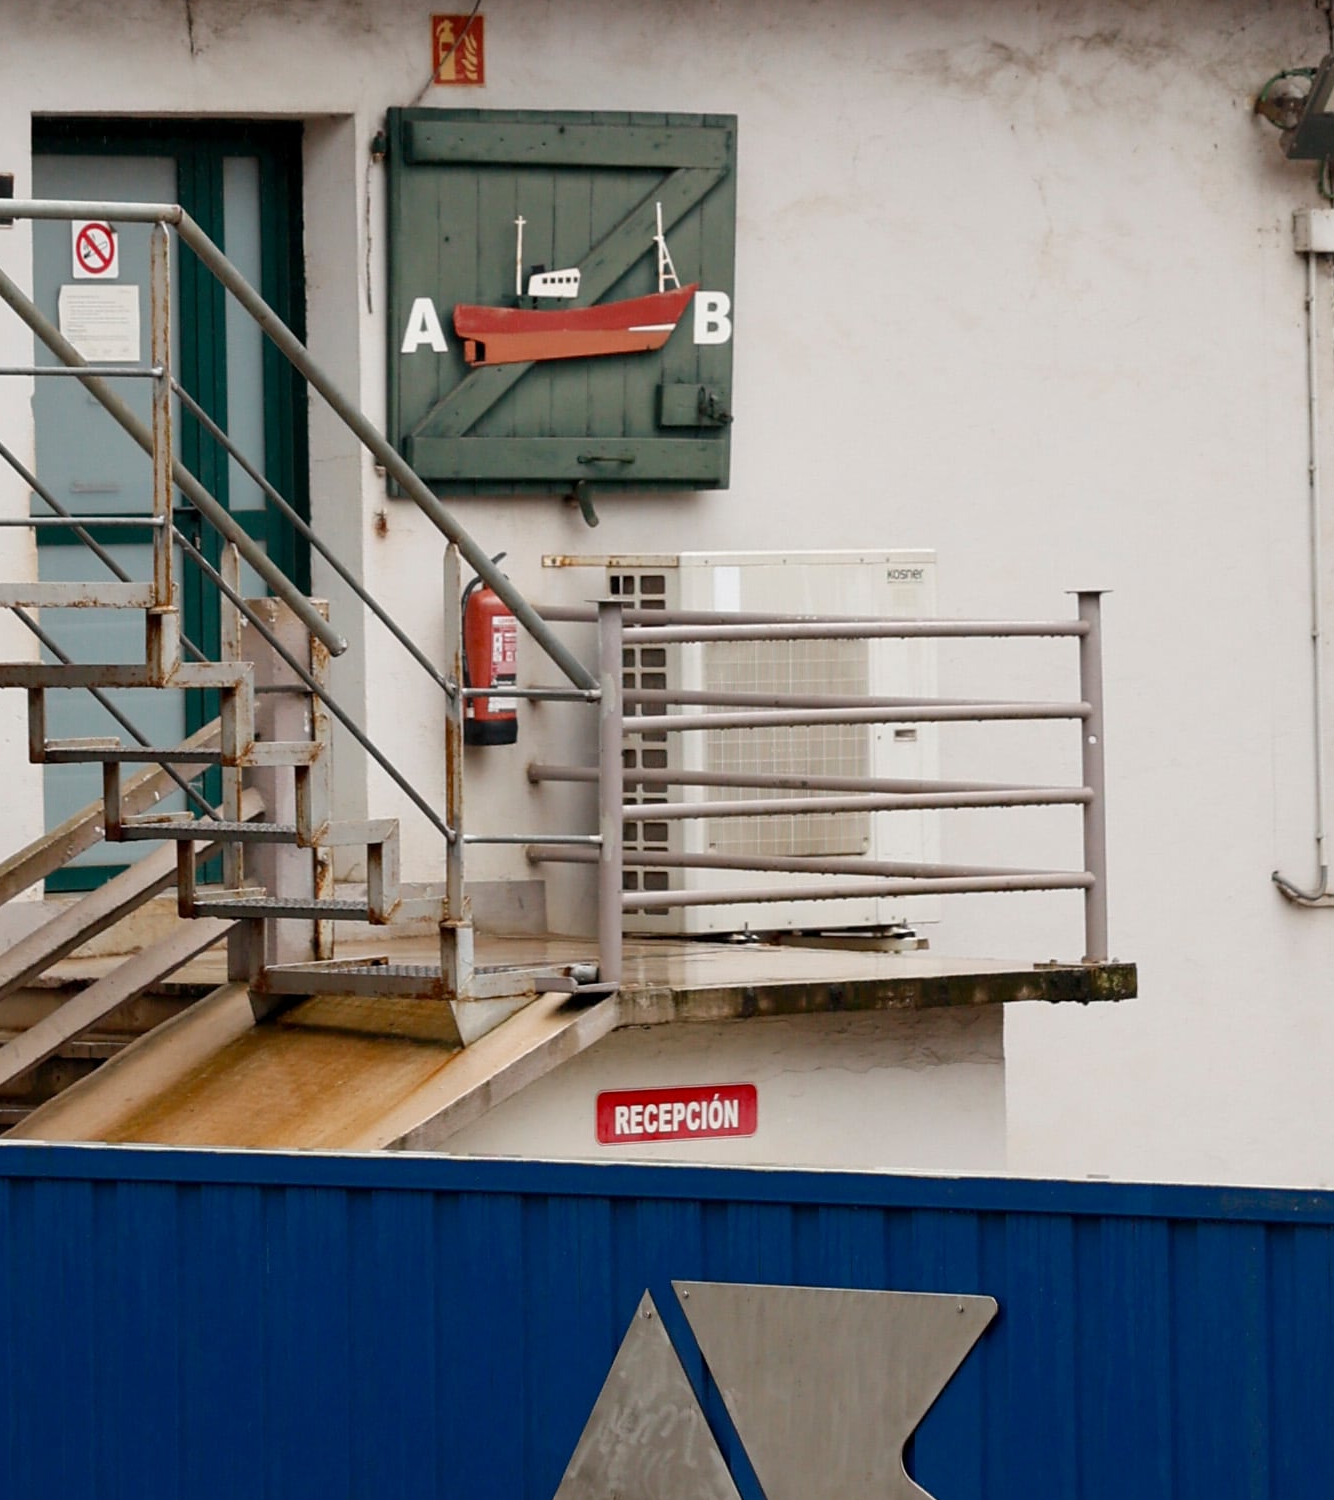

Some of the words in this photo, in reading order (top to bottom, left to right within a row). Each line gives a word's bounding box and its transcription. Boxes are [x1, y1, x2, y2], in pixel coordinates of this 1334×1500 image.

[401, 297, 448, 353] A
[693, 290, 732, 345] B
[614, 1093, 739, 1135] RECEPCIÓN
